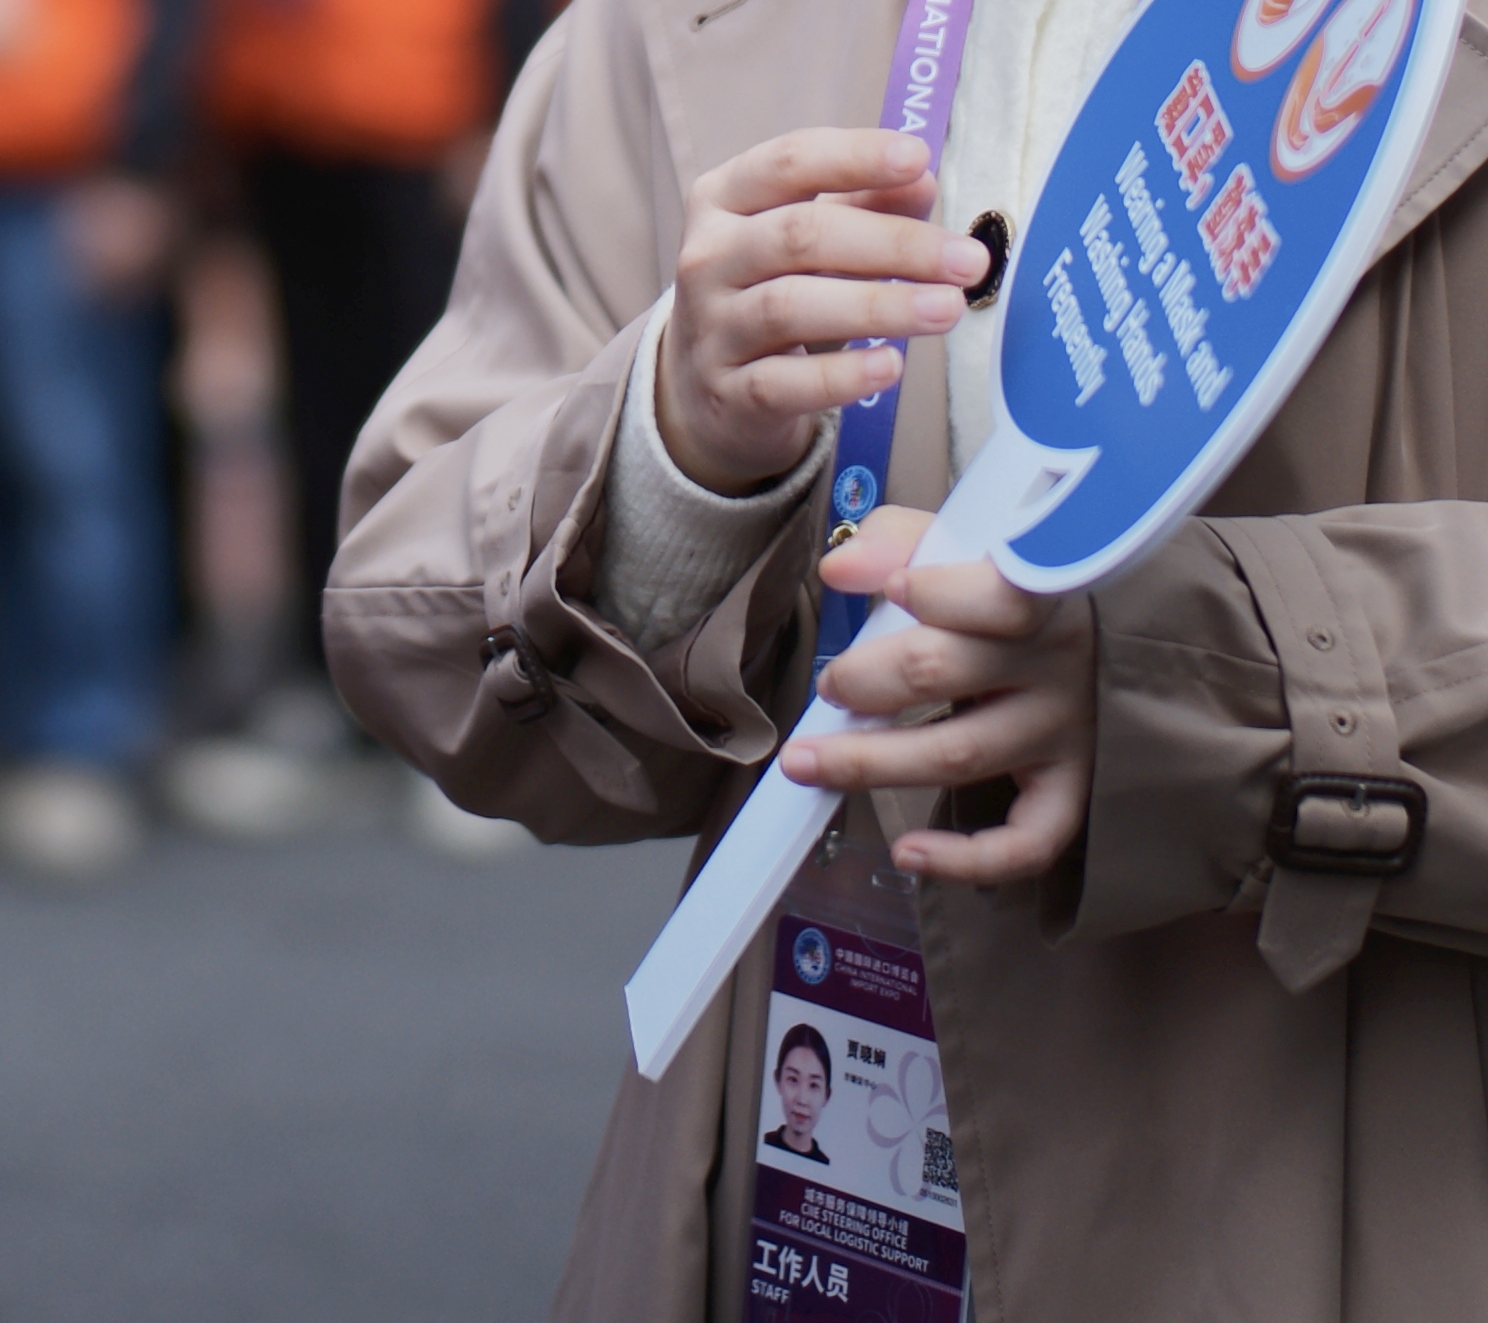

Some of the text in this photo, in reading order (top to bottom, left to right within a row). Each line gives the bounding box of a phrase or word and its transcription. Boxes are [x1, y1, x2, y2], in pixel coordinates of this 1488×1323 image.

[1079, 192, 1168, 407] Washing Hands
[1114, 139, 1235, 412] Wearing a Mask and
[1042, 246, 1109, 407] Frequently
[879, 987, 901, 1001] EXPO
[779, 1209, 930, 1274] FOR LOCAL LOGISTIC SUPPORT
[821, 1209, 870, 1236] STEERING
[871, 1225, 908, 1250] OFFICE
[750, 1277, 791, 1305] STAFF
[753, 1238, 850, 1304] 工作人员
